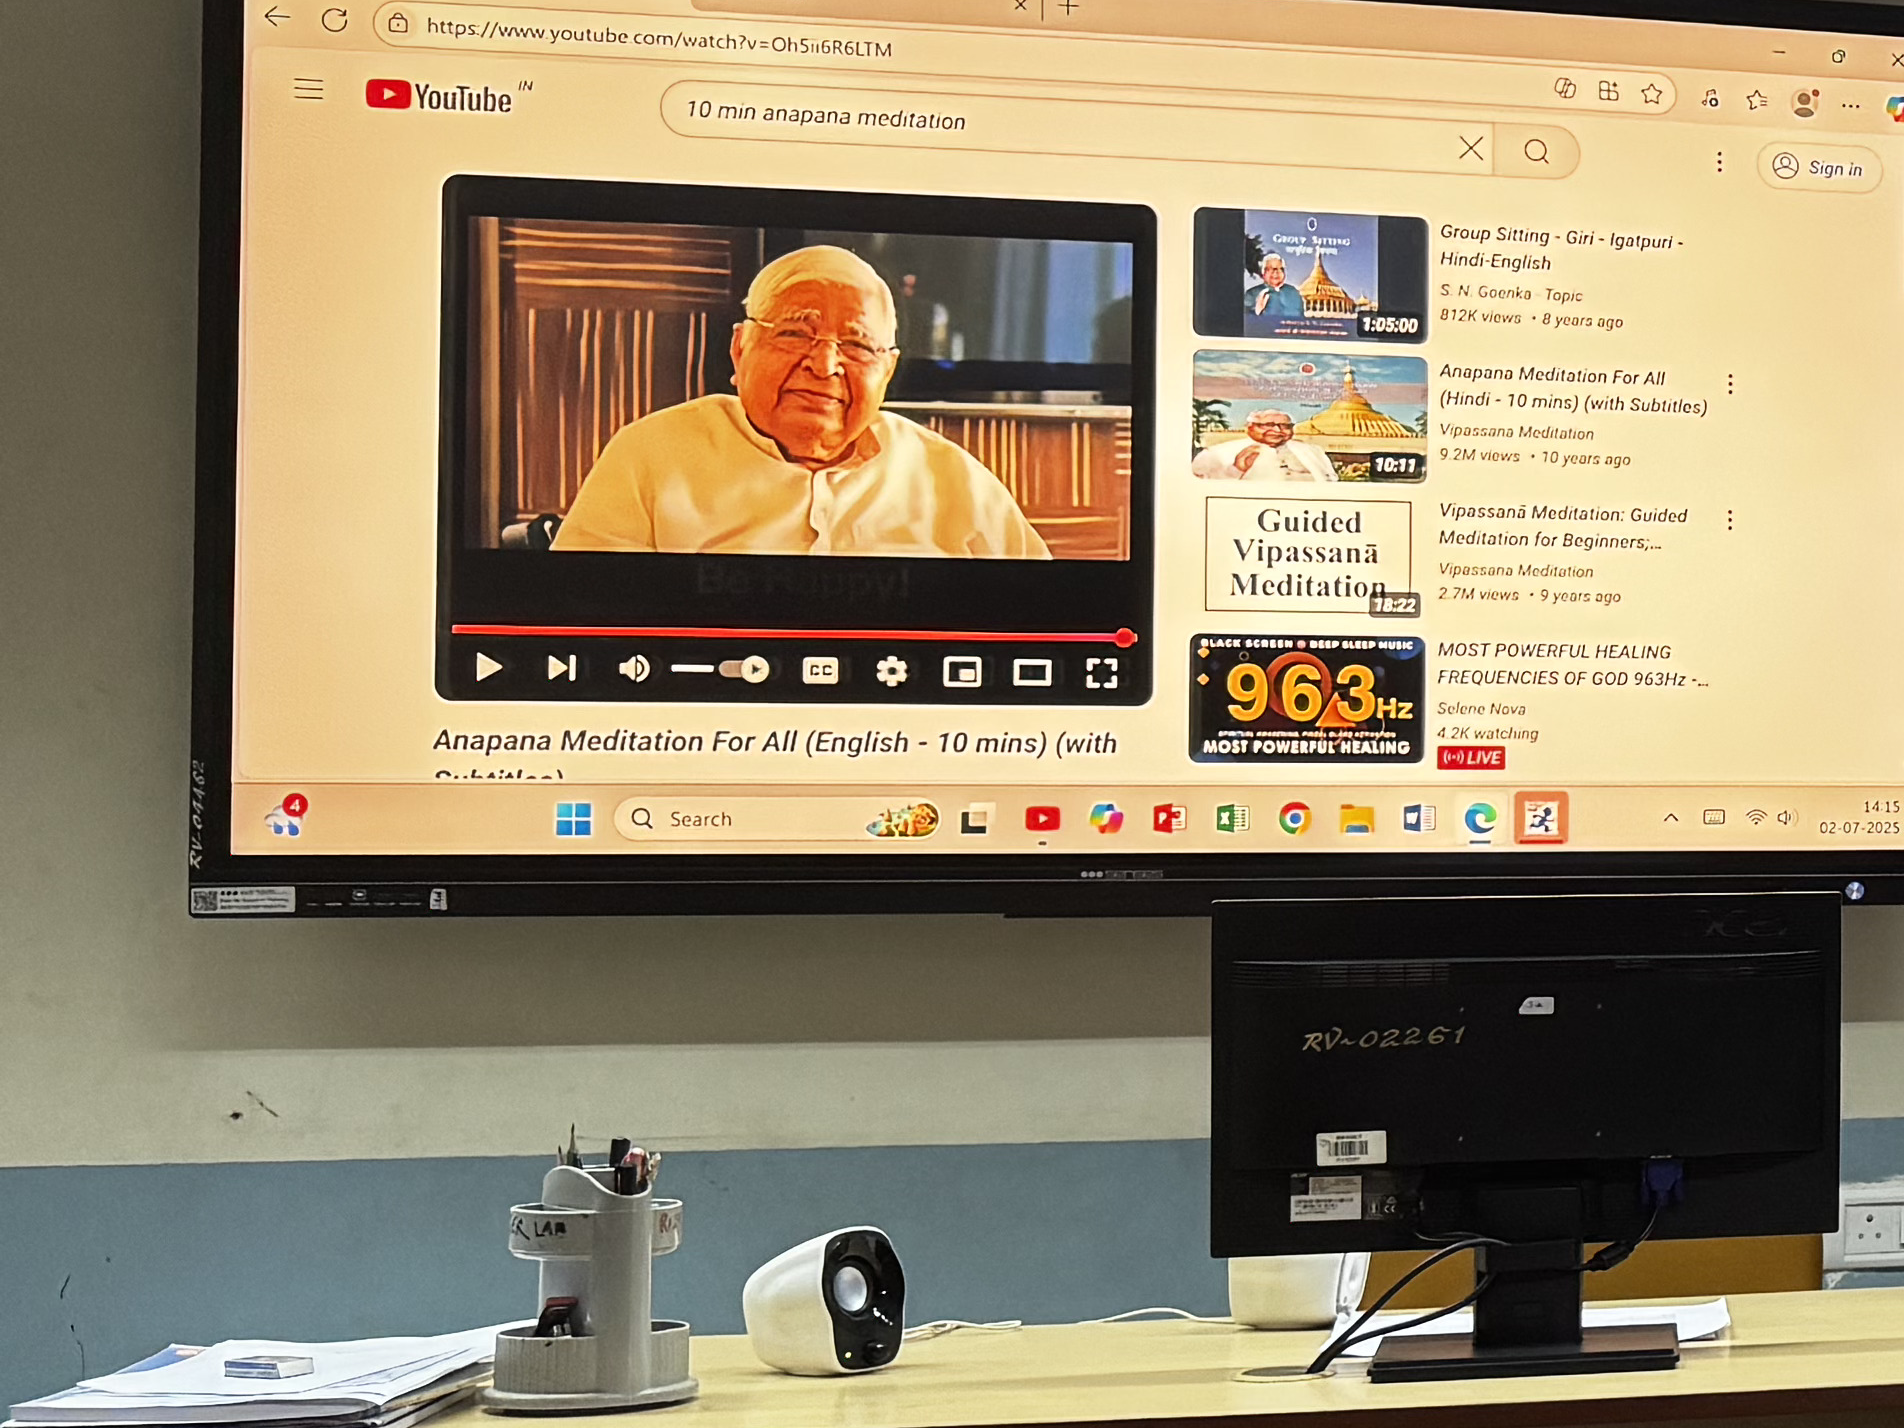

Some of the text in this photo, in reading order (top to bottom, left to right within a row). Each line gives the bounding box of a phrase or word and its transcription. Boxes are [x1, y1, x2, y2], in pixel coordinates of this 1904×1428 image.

[415, 79, 534, 113] YouTube IN
[687, 100, 966, 131] 10 min anapana meditation
[1808, 159, 1863, 179] Sign in
[1440, 223, 1491, 244] Group
[1496, 226, 1550, 247] Sitting
[1566, 230, 1595, 246] Giri
[1609, 232, 1674, 252] Igatpuri
[1440, 251, 1552, 273] Hindi-English
[1478, 285, 1532, 301] Goenka
[1545, 288, 1584, 305] Topic
[1362, 316, 1419, 334] 1:05:00
[1440, 308, 1624, 332] 812K views 8 years ago
[1439, 363, 1666, 386] Anapana Meditation For All
[1440, 390, 1491, 409] (Hindi
[1507, 393, 1528, 408] 10
[1531, 394, 1580, 414] mins)
[1583, 395, 1625, 415] (with
[1629, 398, 1709, 418] Subtitles)
[1440, 423, 1595, 441] Vipassana Meditation
[1374, 457, 1417, 473] 10:11
[1439, 447, 1632, 469] 9.2M views 10 years ago
[1257, 508, 1362, 534] Guided
[1439, 503, 1688, 523] Vipassanā Meditation: Guided
[1439, 530, 1529, 546] Meditation
[1534, 531, 1558, 547] for
[1232, 538, 1379, 568] Vipassanā
[1439, 562, 1594, 579] Vipassana Meditation
[1229, 573, 1387, 598] Meditation
[1373, 597, 1417, 613] 18:22
[1438, 587, 1622, 607] 2.7M views 9 years ago
[1200, 638, 1414, 650] BLACK SCREEN DEEP SLEEP MUSIC
[1438, 642, 1672, 660] MOST POWERFUL HEALING
[1437, 669, 1560, 686] FREQUENCIES
[1564, 670, 1588, 686] OF
[1592, 671, 1629, 686] GOD
[1634, 672, 1686, 687] 963Hz
[1437, 701, 1527, 716] Selene Nova
[1437, 726, 1539, 743] 4.2K watching
[432, 729, 552, 757] Anapana
[560, 728, 704, 753] Meditation
[712, 731, 757, 753] For
[761, 730, 799, 753] All
[805, 730, 909, 759] (English
[938, 731, 968, 754] 10
[975, 730, 1048, 760] mins)
[1055, 731, 1118, 760] (with
[1202, 739, 1412, 756] MOST POWERFUL HEALING
[1466, 749, 1503, 766] LIVE
[288, 798, 301, 813] 4
[1864, 800, 1901, 813] 14:15
[670, 811, 732, 827] Search
[1819, 821, 1901, 834] 02-07-2025
